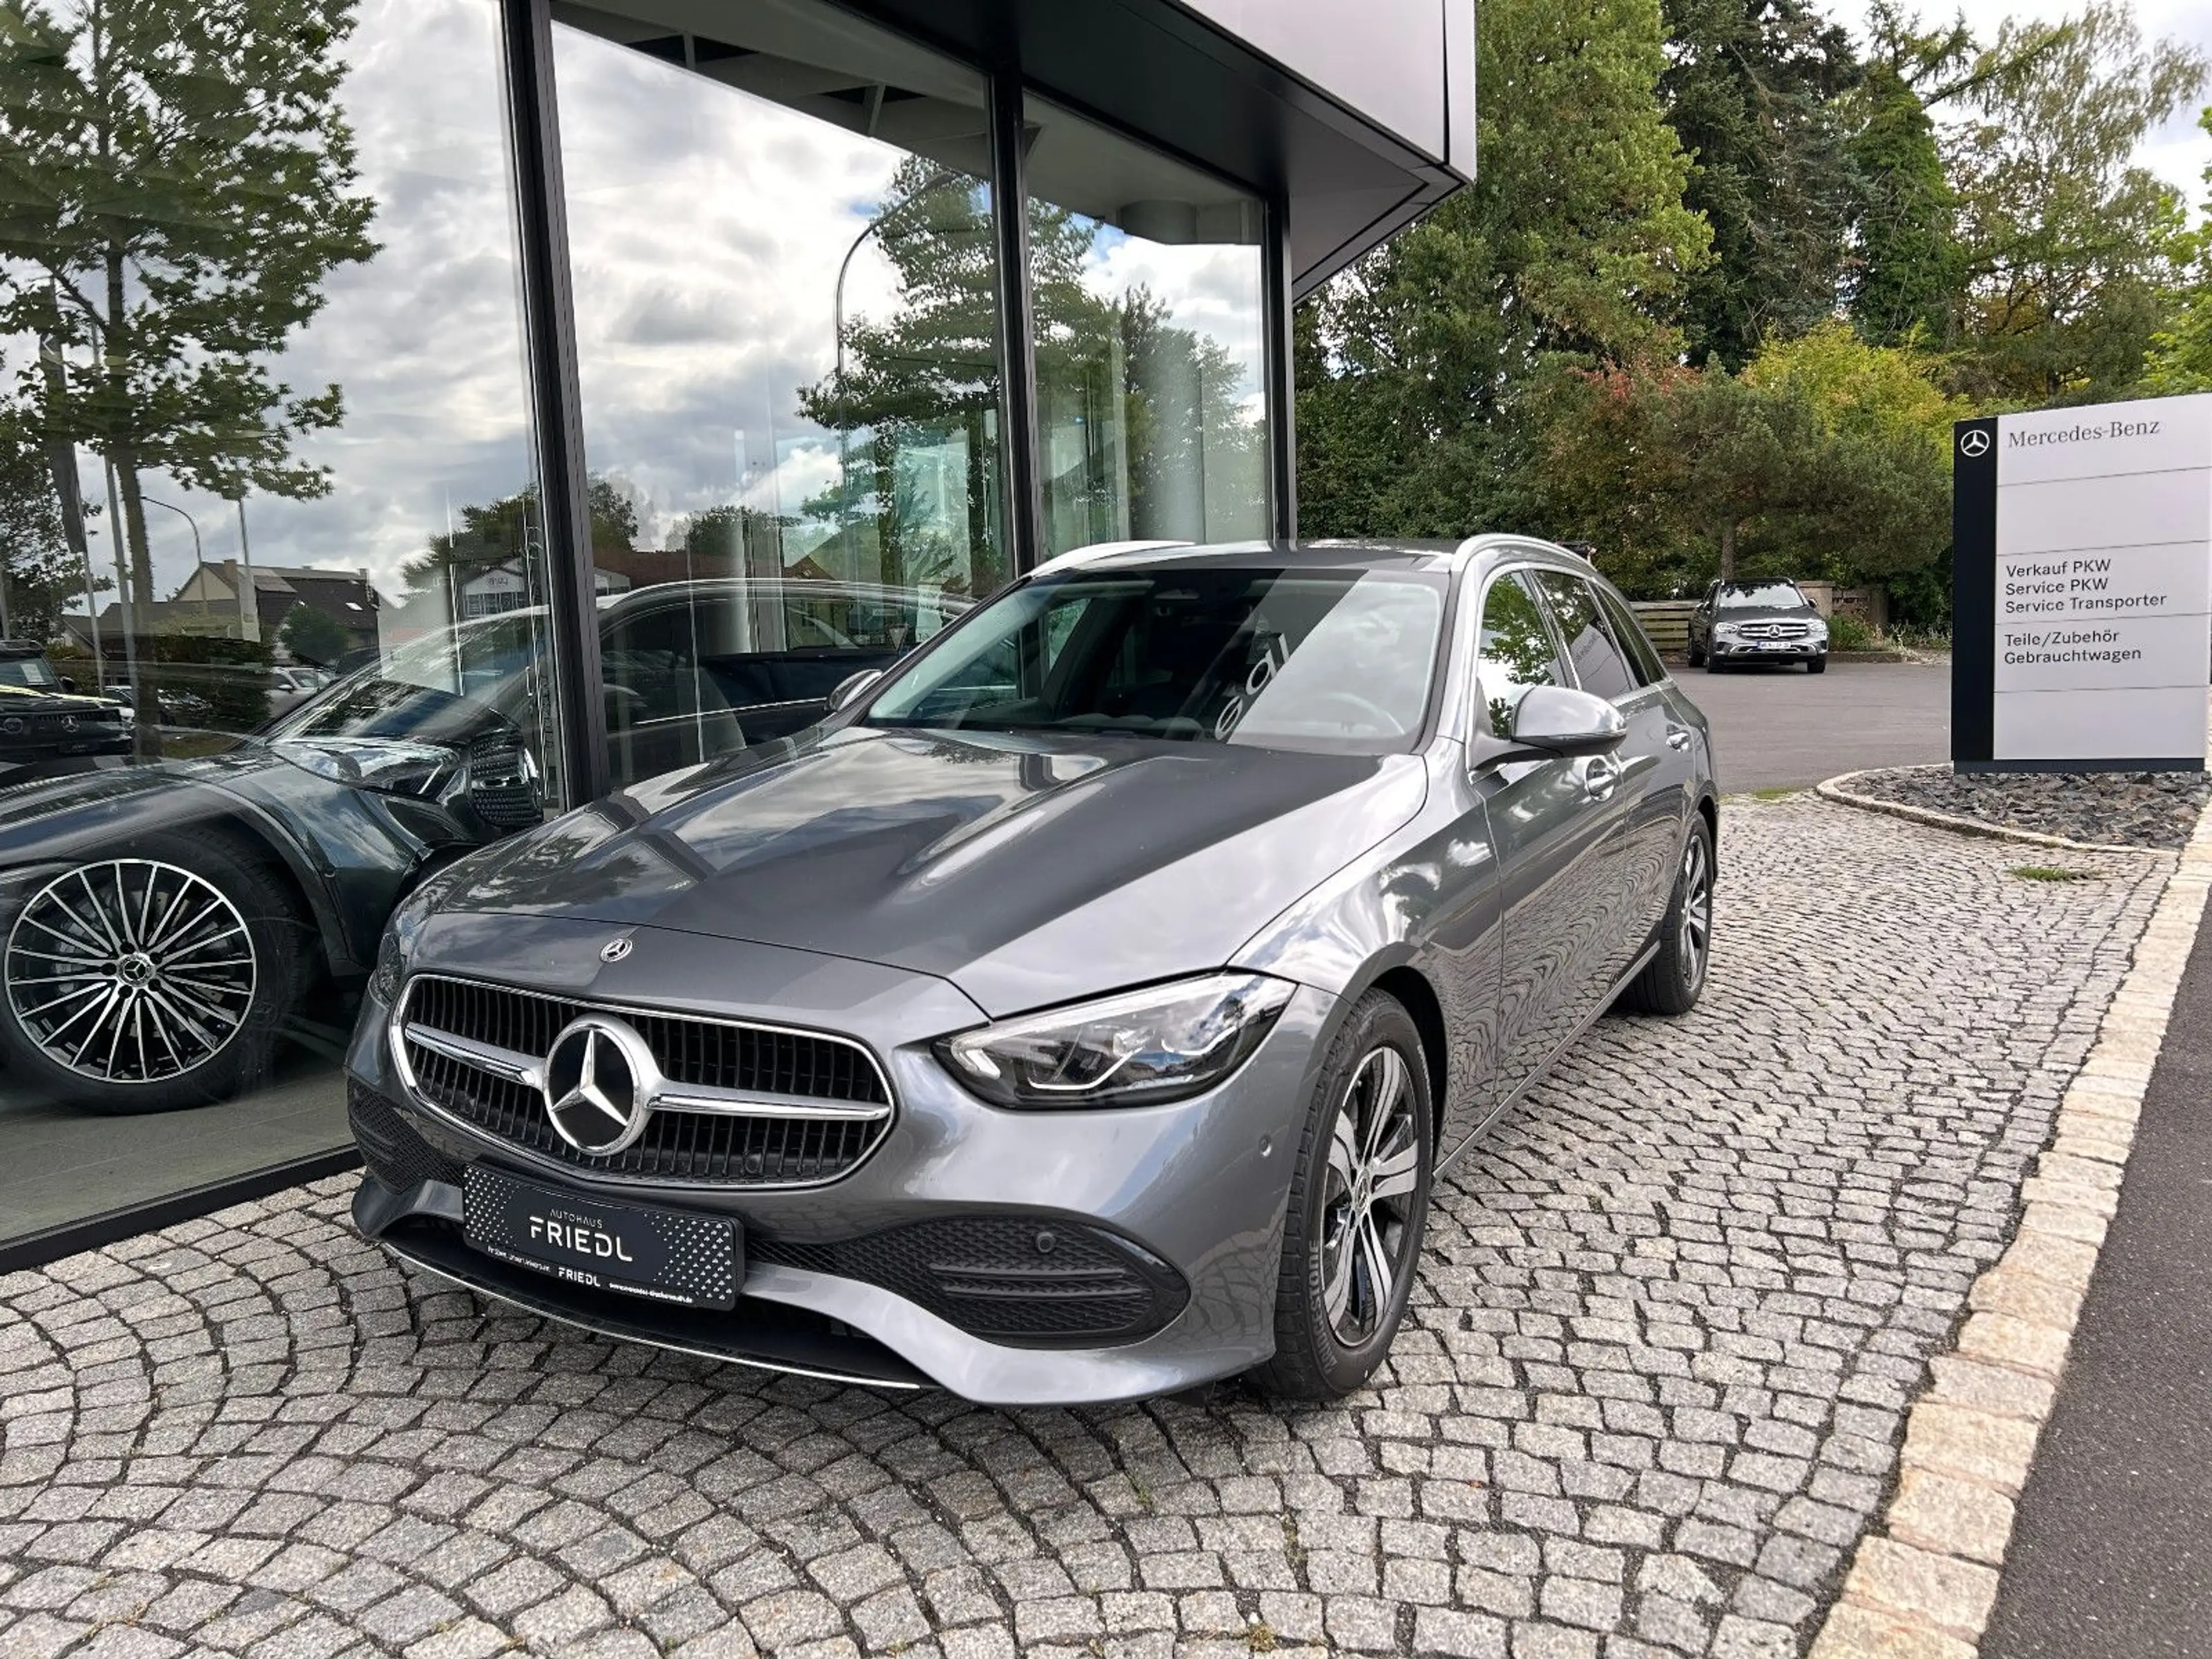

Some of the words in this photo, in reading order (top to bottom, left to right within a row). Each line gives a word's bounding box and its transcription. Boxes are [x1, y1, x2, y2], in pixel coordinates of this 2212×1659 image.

[2009, 421, 2160, 448] Mercedes-Benz
[2006, 561, 2068, 578] Verkauf
[2073, 559, 2111, 573] PKW
[2006, 581, 2065, 596] Service
[2070, 578, 2108, 592] PKW
[2005, 599, 2065, 614] Service
[2070, 594, 2168, 611] Transporter
[2004, 629, 2120, 648] Teile/Zubehör
[2003, 649, 2142, 665] Gebrauchtwagen
[550, 1209, 603, 1228] AUTOHAUS
[529, 1216, 632, 1262] FRIEDL
[558, 1267, 601, 1287] FRIEDL
